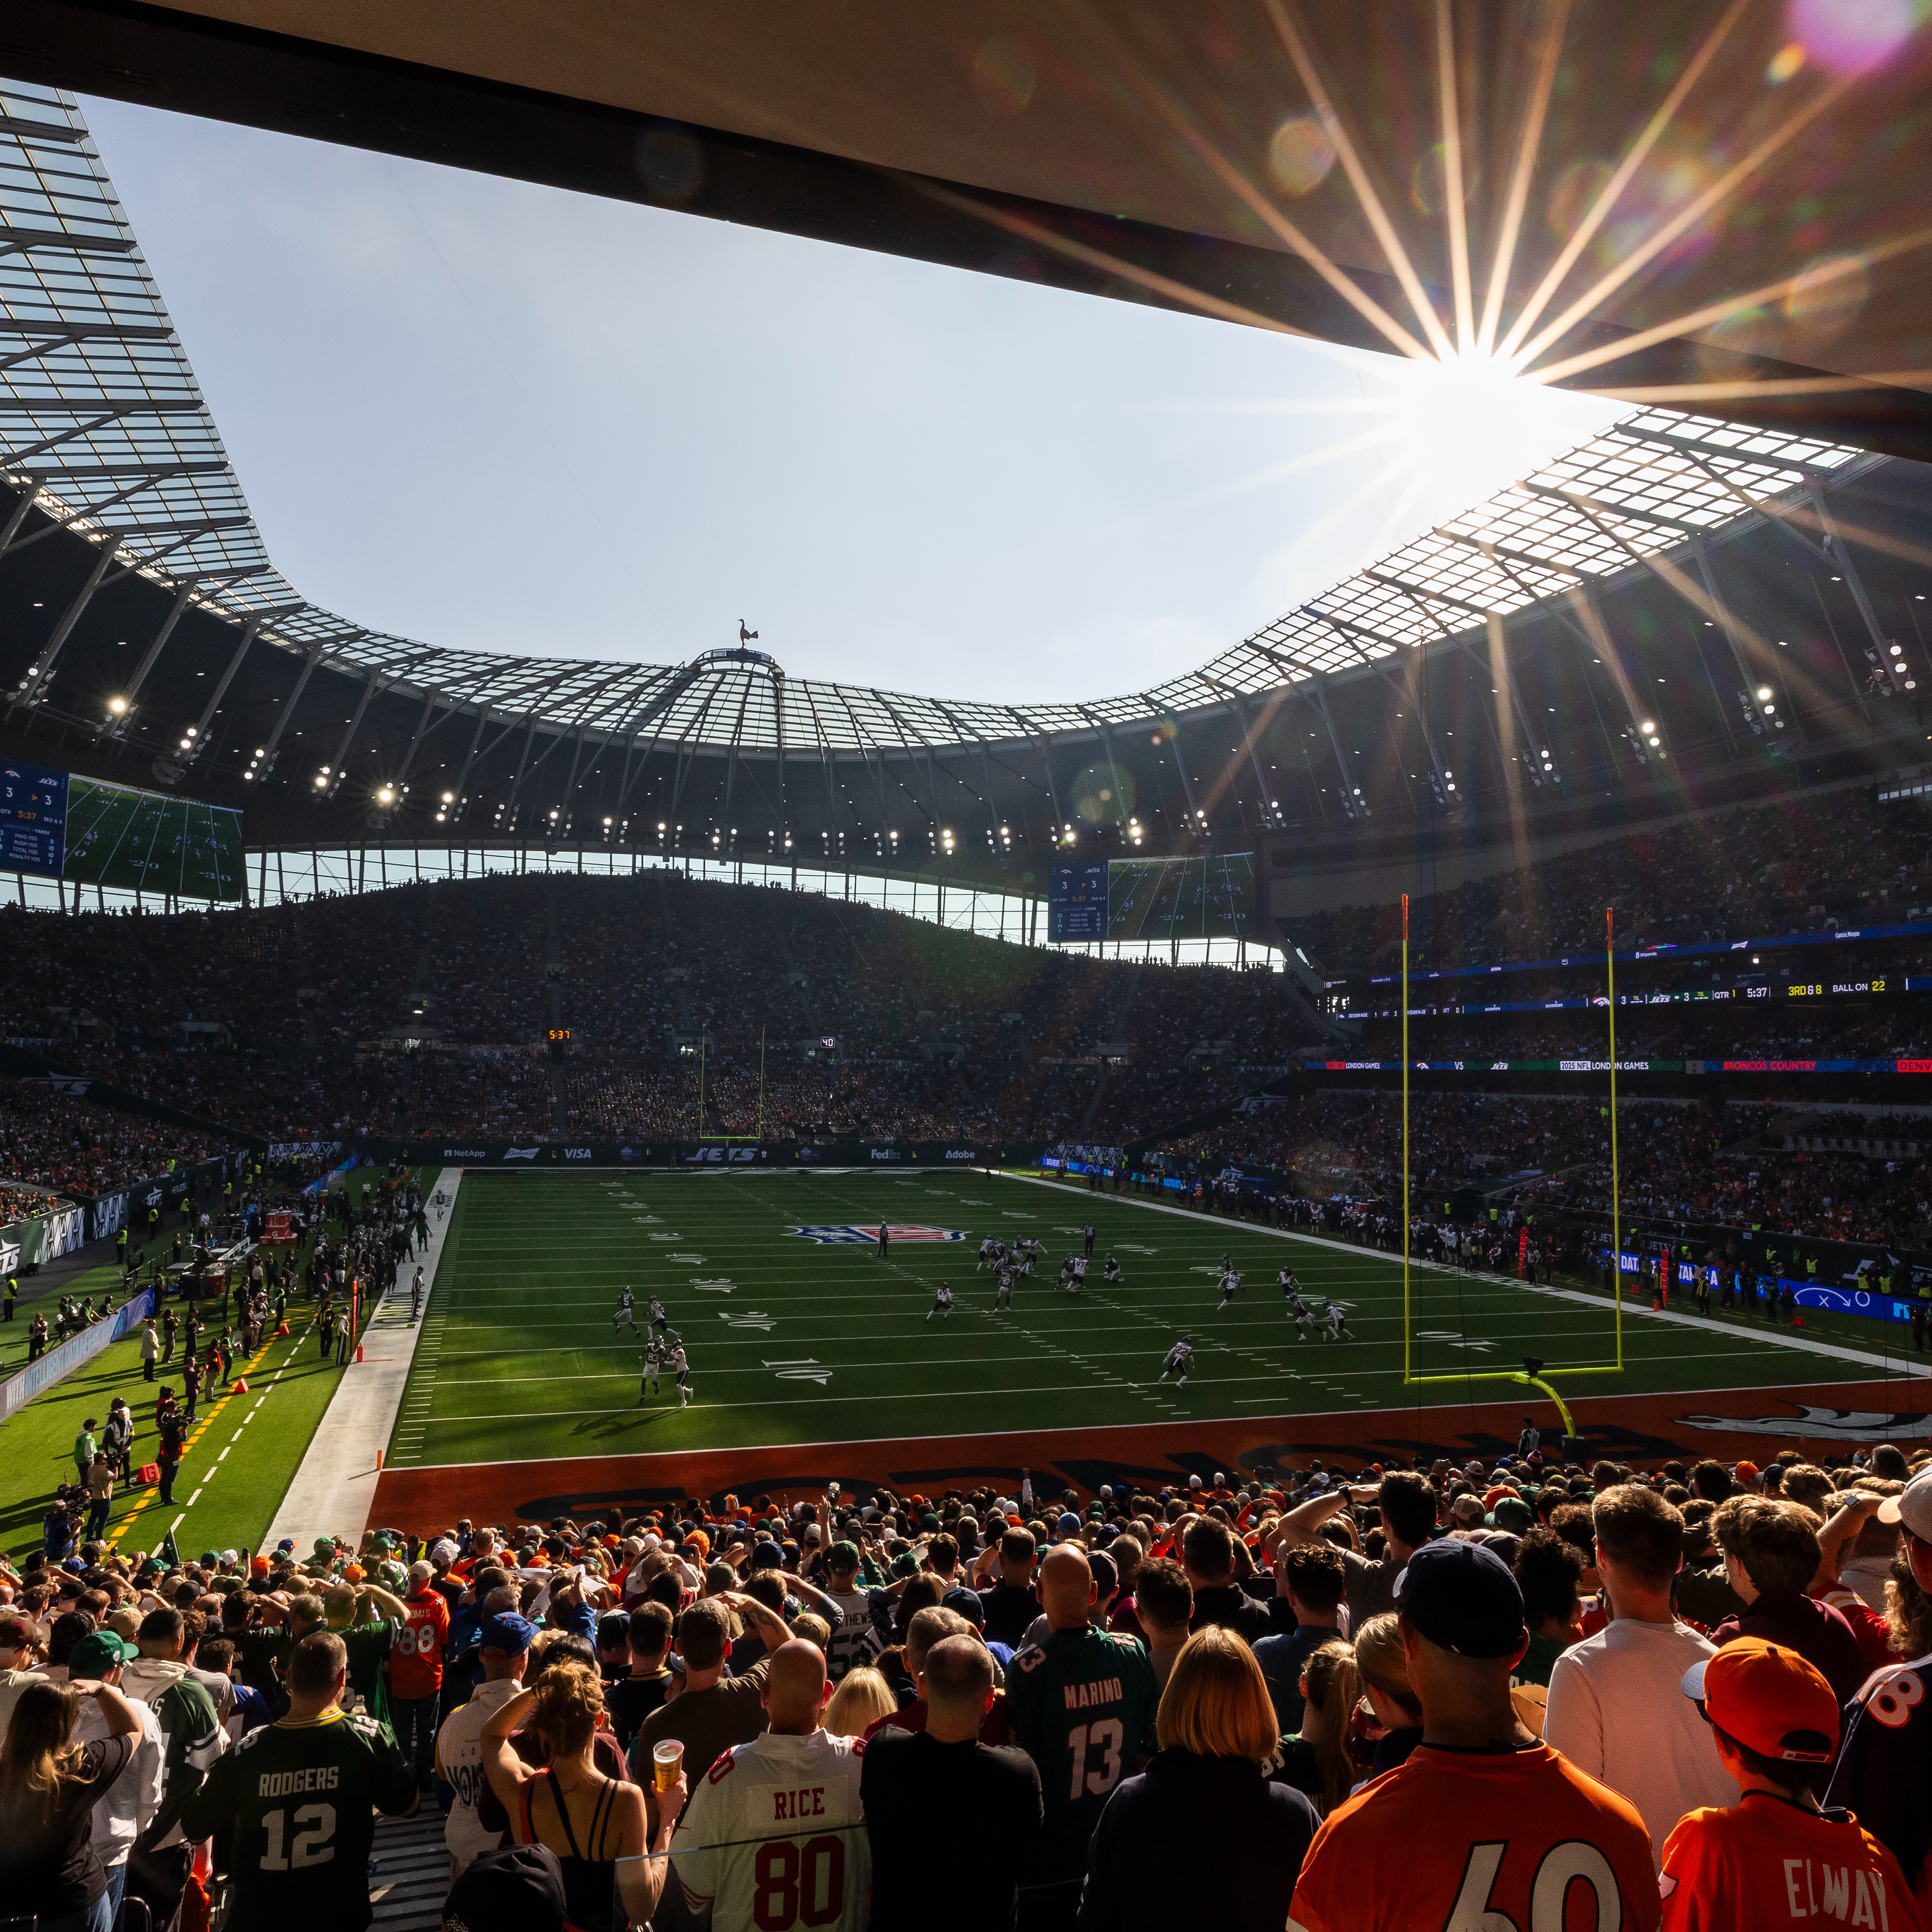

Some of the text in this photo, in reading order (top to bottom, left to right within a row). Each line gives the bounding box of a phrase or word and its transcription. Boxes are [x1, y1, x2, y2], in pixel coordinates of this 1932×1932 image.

[6, 787, 13, 797] 3
[45, 795, 52, 805] 3
[18, 810, 37, 820] 5:37
[1789, 985, 1822, 996] 3RD & 8
[1833, 984, 1853, 992] BALL
[1872, 981, 1885, 991] 22
[1649, 992, 1689, 1003] JETS 3
[1732, 989, 1736, 997] 1
[1747, 987, 1767, 998] 5:37
[1621, 996, 1626, 1005] 3
[550, 1031, 570, 1039] 5:37
[1455, 1062, 1464, 1070] VS
[1491, 1061, 1508, 1070] JETS
[1723, 1061, 1816, 1071] BRONCOS COUNTRY
[563, 1149, 592, 1158] VISA
[686, 1148, 757, 1161] JETS
[871, 1149, 901, 1159] FedEx
[945, 1150, 975, 1159] Adobe
[1621, 1255, 1639, 1271] DAT
[623, 1297, 629, 1306] 5
[1176, 1346, 1188, 1355] 22
[399, 1624, 435, 1655] 88
[1064, 1677, 1122, 1710] MARINO
[352, 1715, 379, 1738] 12
[1067, 1718, 1123, 1801] 13
[258, 1766, 339, 1797] RODGERS
[774, 1787, 825, 1820] RICE
[259, 1803, 337, 1871] 12
[753, 1835, 845, 1932] 80
[1441, 1838, 1624, 1932] 60
[1783, 1858, 1889, 1932] ELWAY
